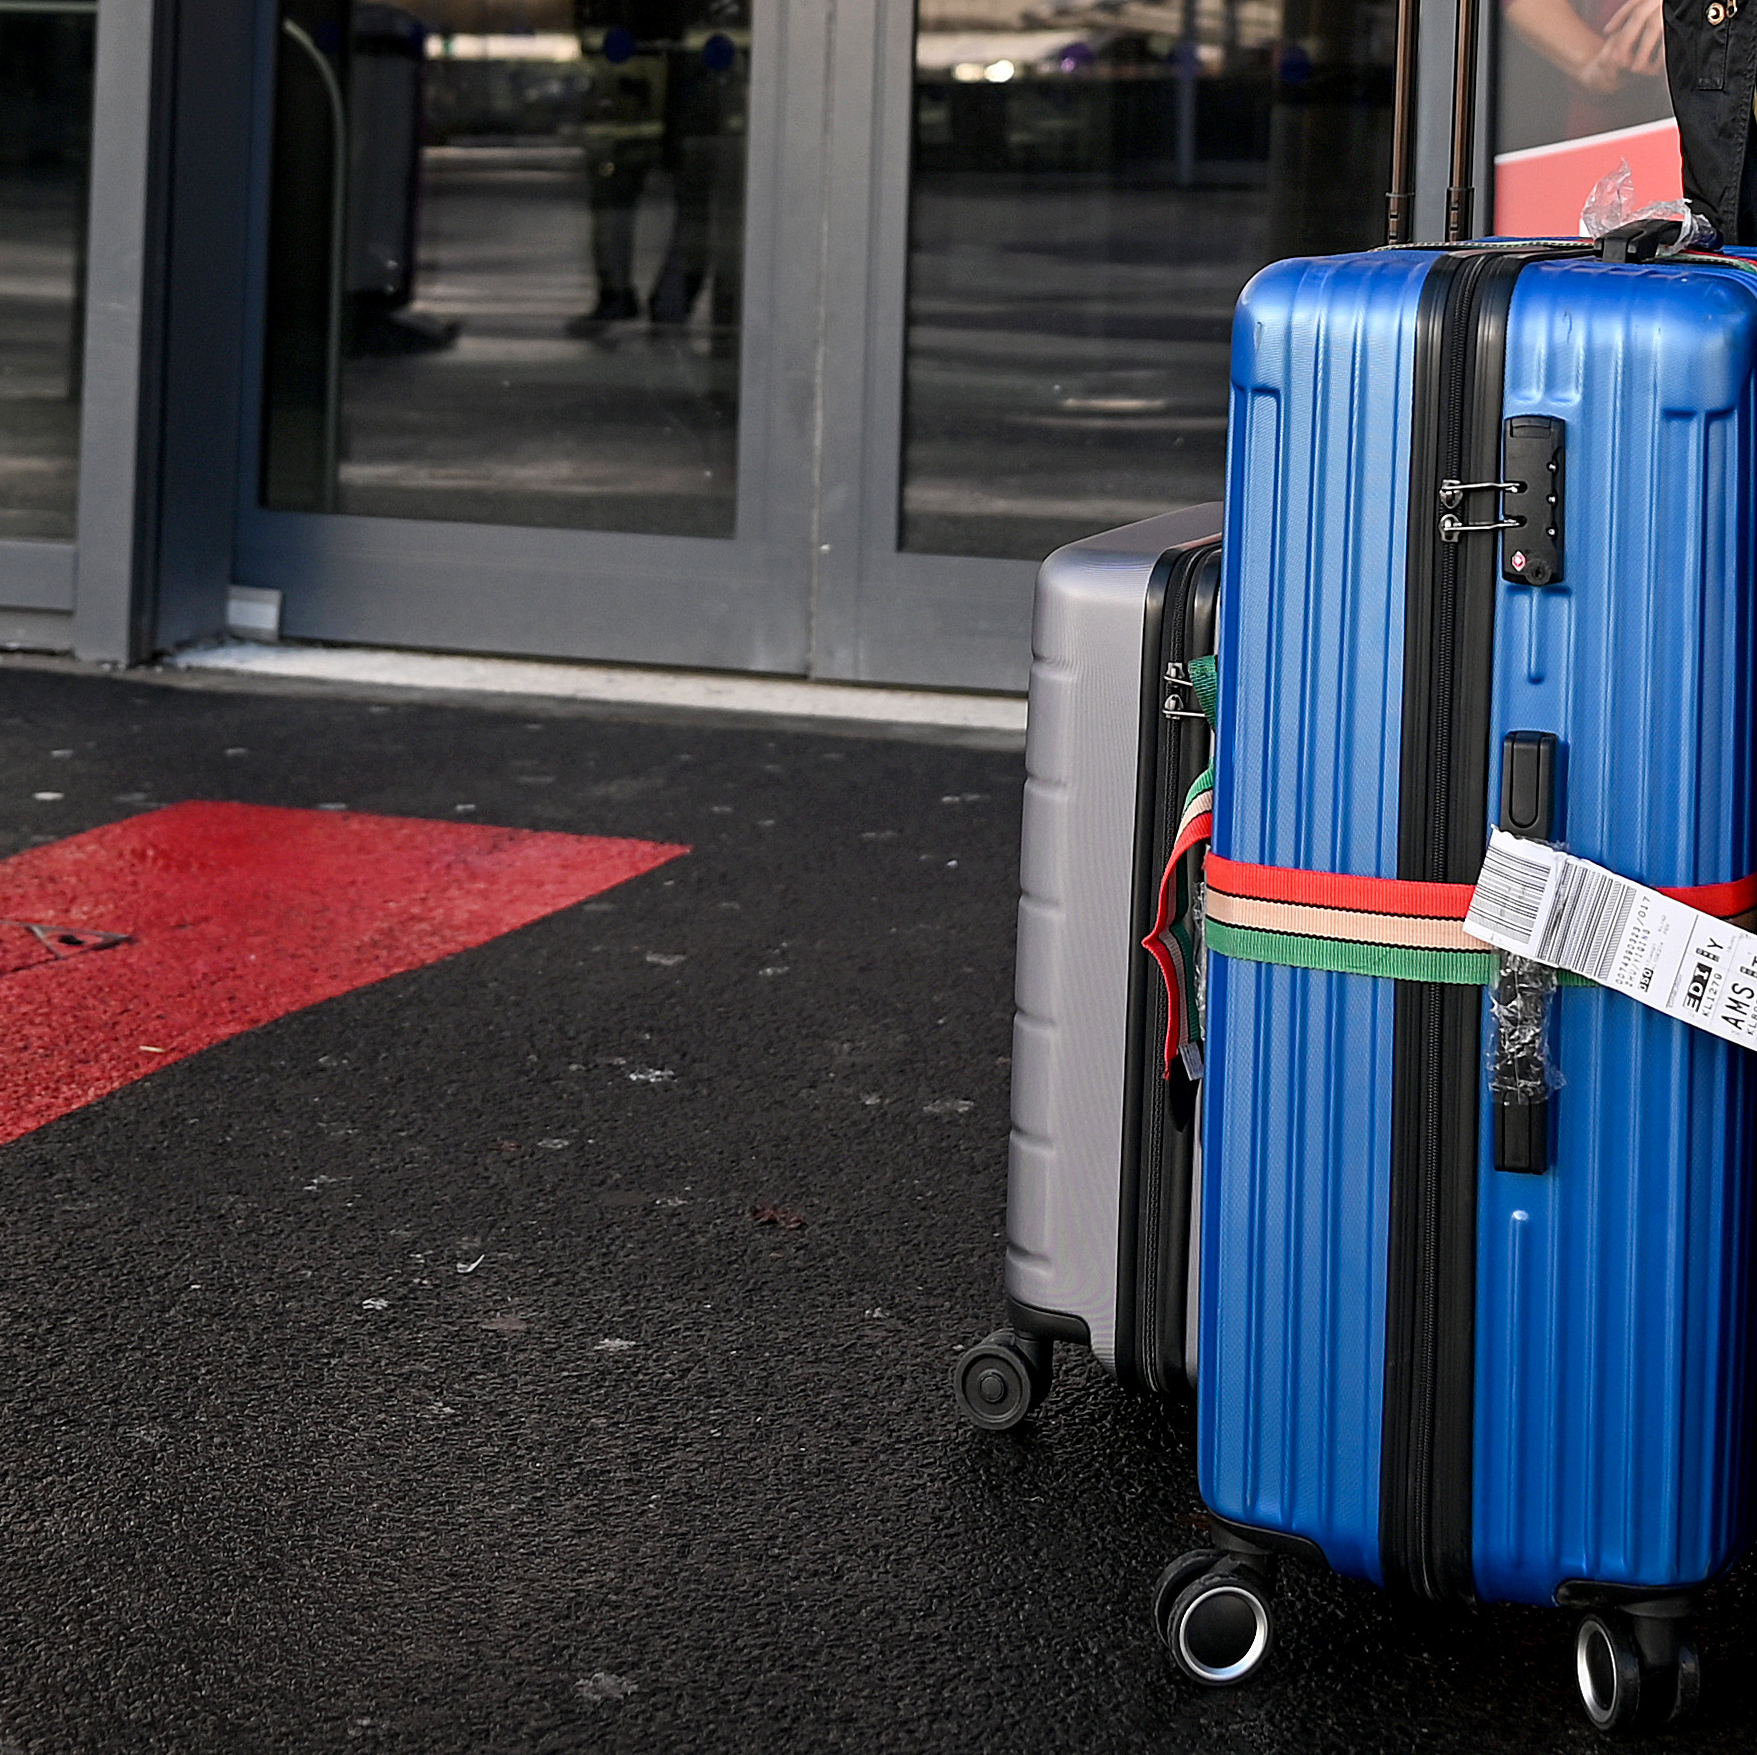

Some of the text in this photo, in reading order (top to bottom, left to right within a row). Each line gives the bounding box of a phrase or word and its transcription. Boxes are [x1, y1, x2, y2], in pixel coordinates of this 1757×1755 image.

[1706, 937, 1724, 950] Y
[1683, 963, 1712, 1012] EDI
[1721, 982, 1755, 1031] AMS
